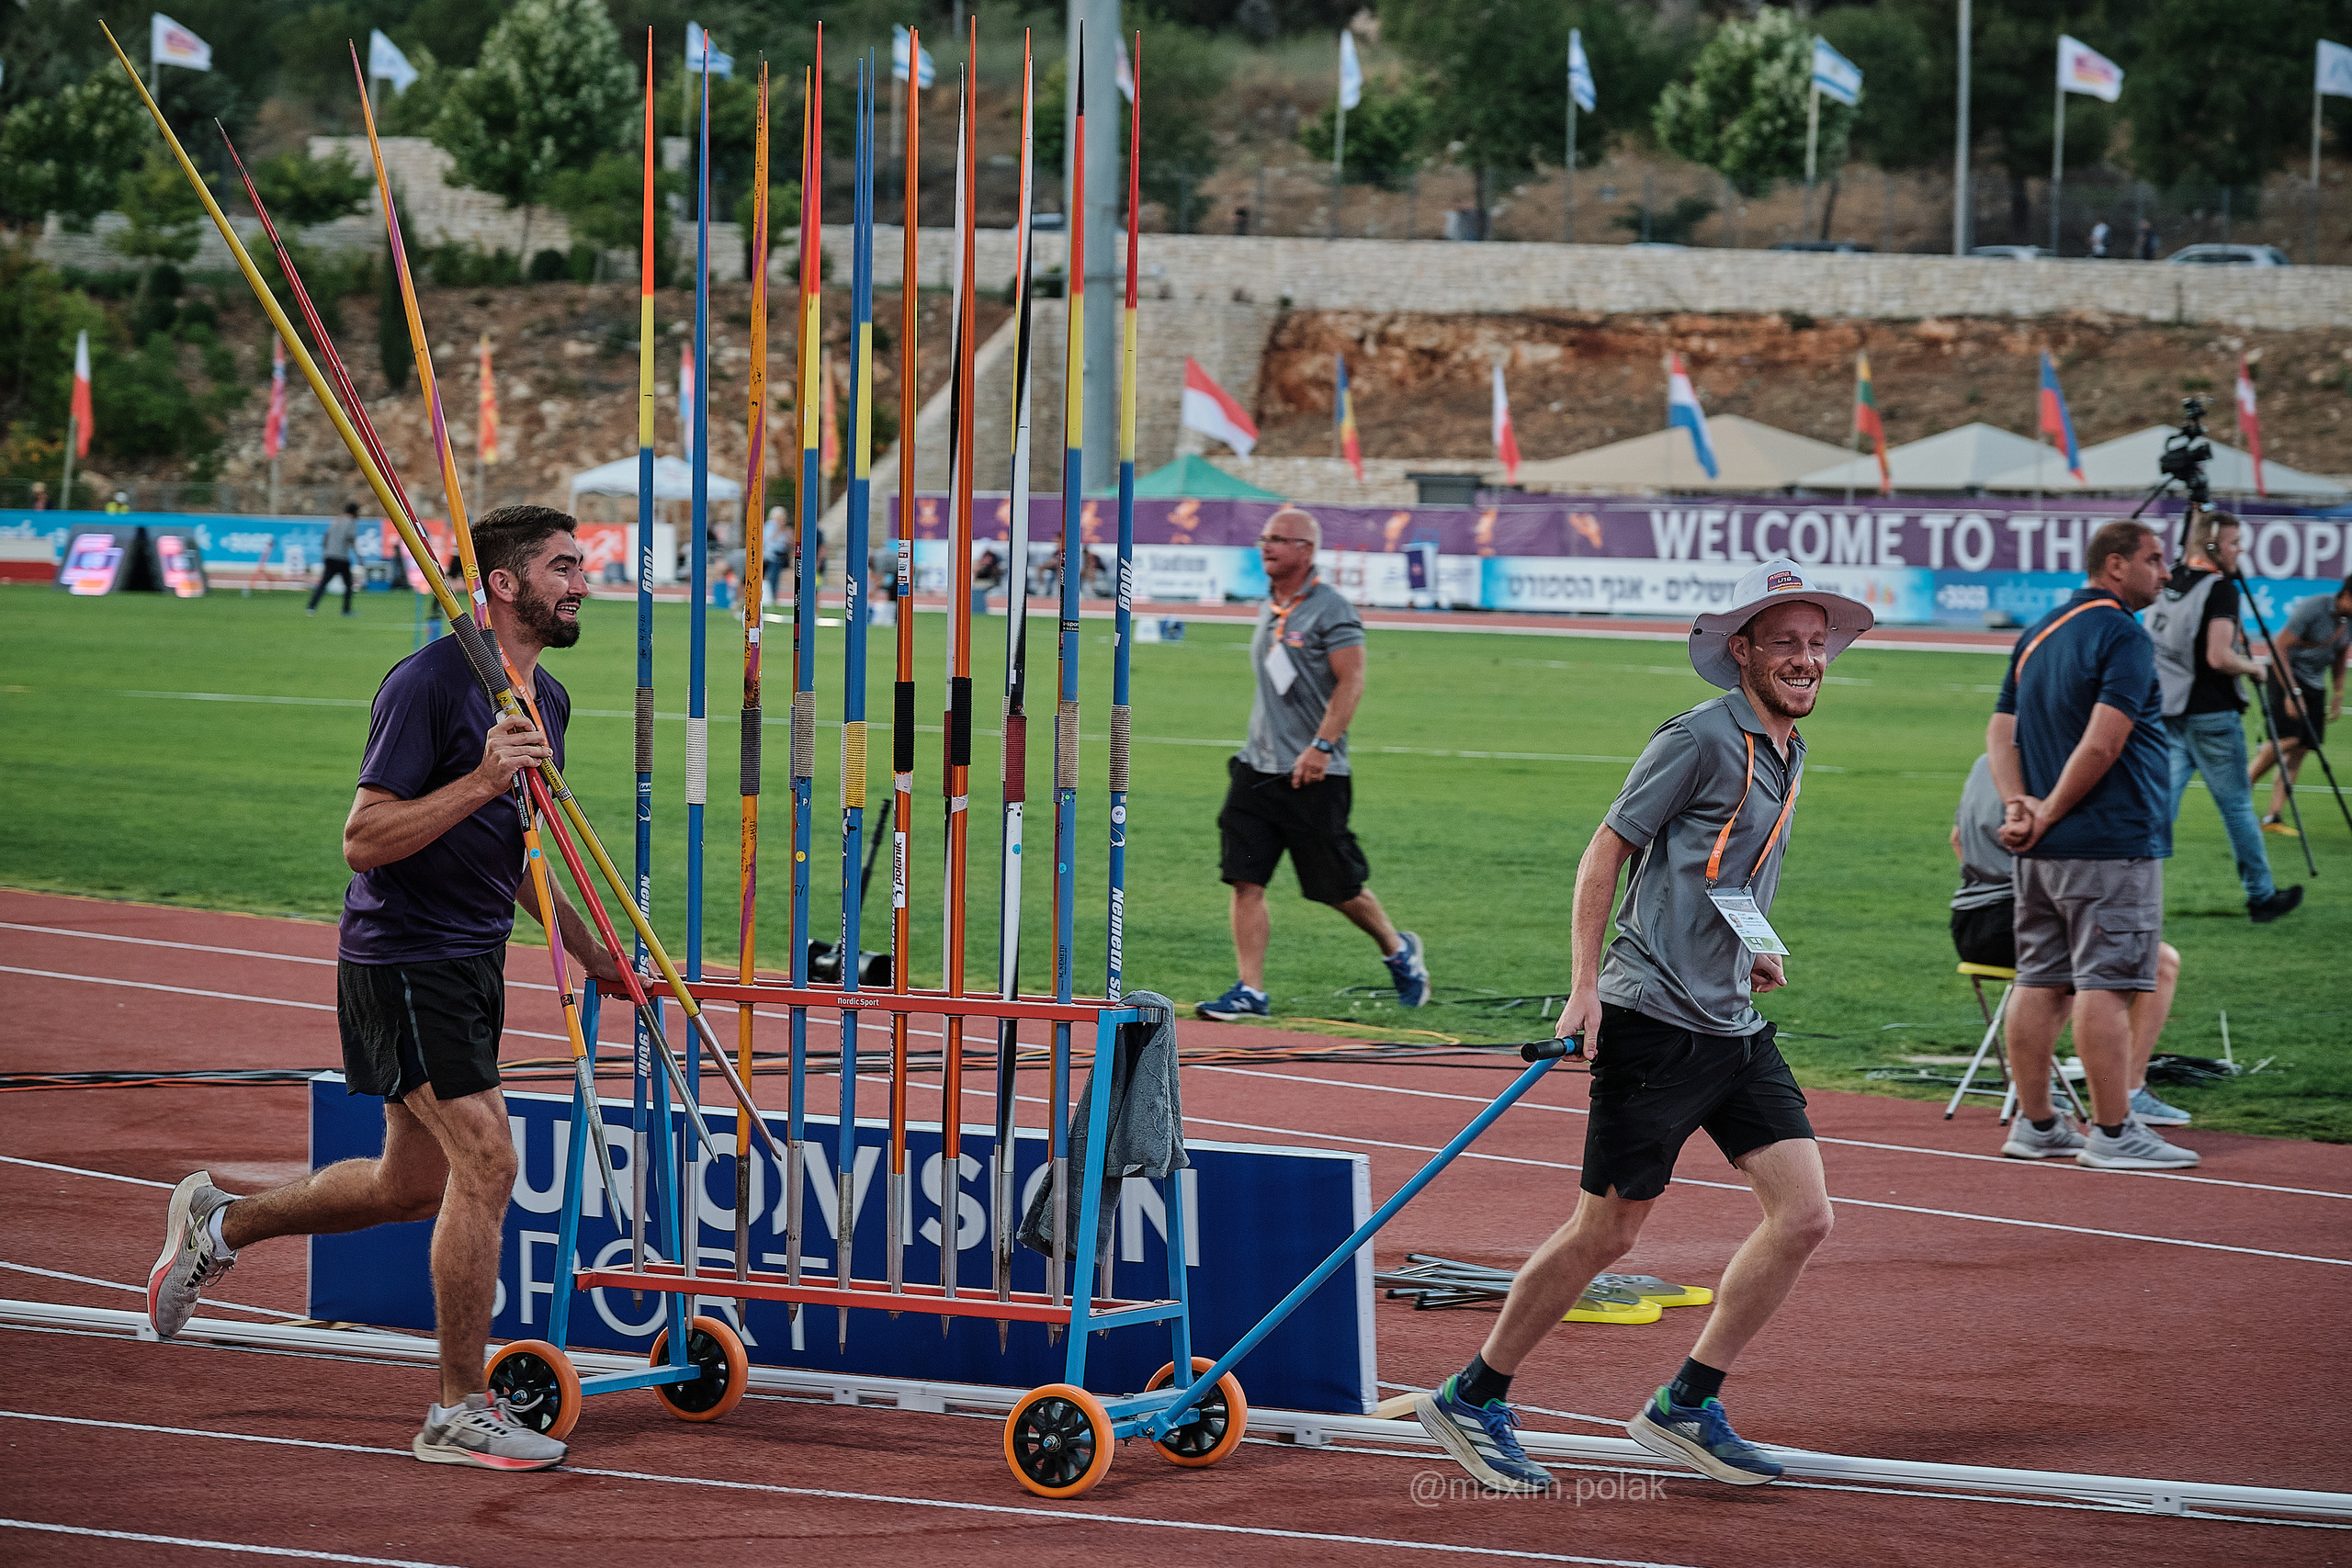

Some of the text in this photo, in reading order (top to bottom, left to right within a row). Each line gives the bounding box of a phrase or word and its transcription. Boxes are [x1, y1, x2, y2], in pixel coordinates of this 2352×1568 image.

[1650, 509, 1905, 566] WELCOME
[1919, 514, 1995, 572] TO
[1118, 557, 1133, 613] 700g
[895, 840, 904, 887] polanik
[1110, 886, 1125, 973] Nemeth
[860, 998, 880, 1008] Sport
[492, 1229, 830, 1352] PORT
